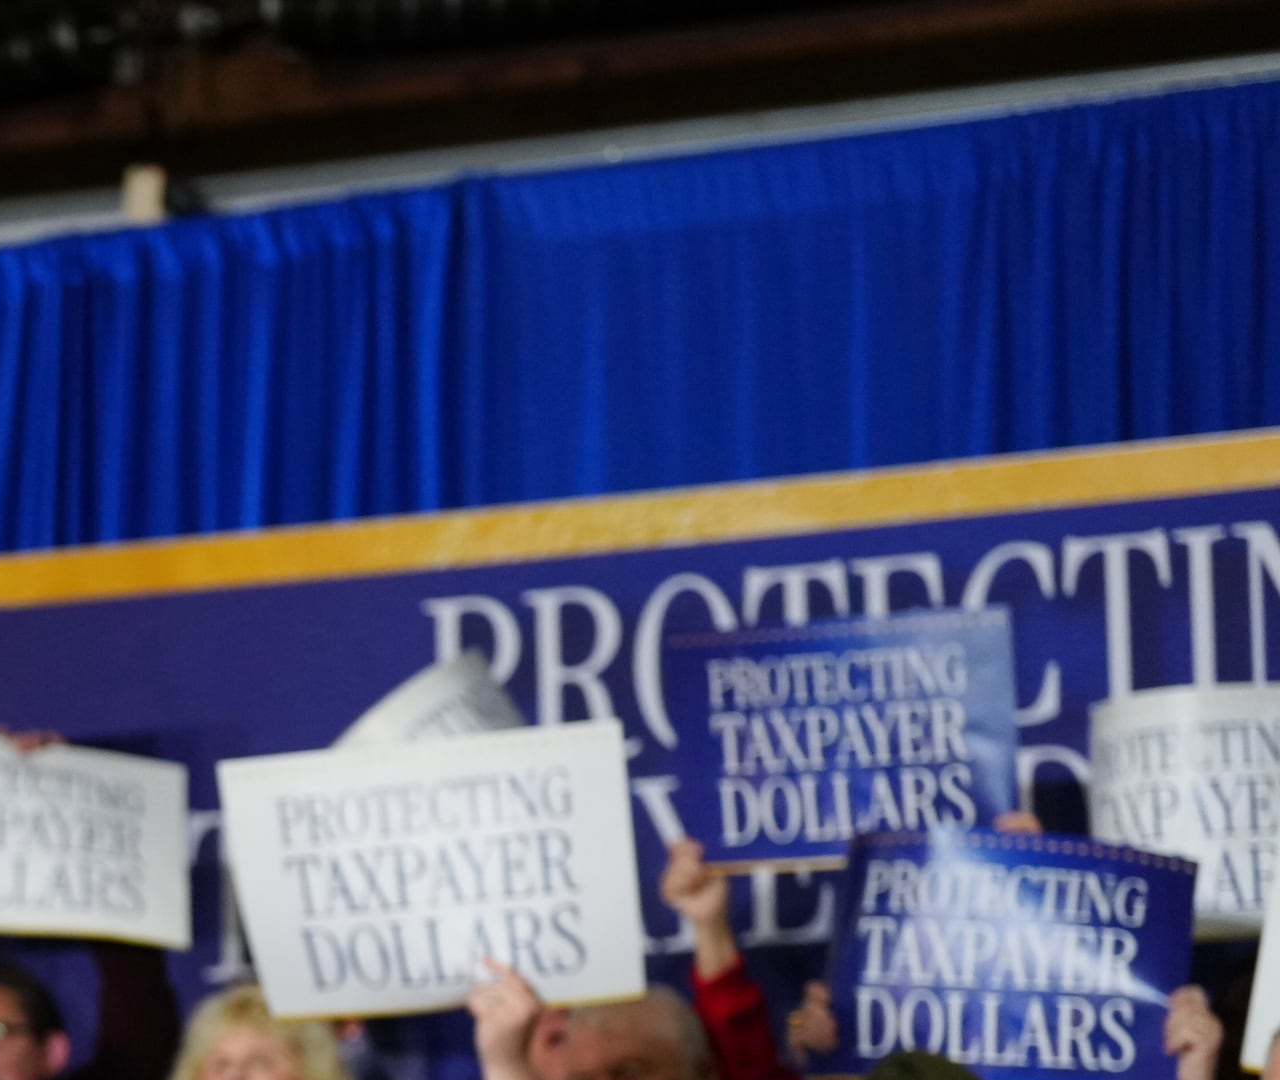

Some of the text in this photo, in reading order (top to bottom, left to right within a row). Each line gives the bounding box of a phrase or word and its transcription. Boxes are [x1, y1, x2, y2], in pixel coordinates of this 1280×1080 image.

[707, 643, 968, 712] PROTECTING
[709, 697, 970, 776] TAXPAYER
[275, 765, 573, 851] PROTECTING
[720, 763, 977, 848] DOLLARS
[280, 829, 583, 921] TAXPAYER
[860, 858, 1148, 929] PROTECTING
[299, 904, 588, 995] DOLLARS
[856, 915, 1139, 1000] TAXPAYER
[855, 986, 1137, 1074] DOLLARS
